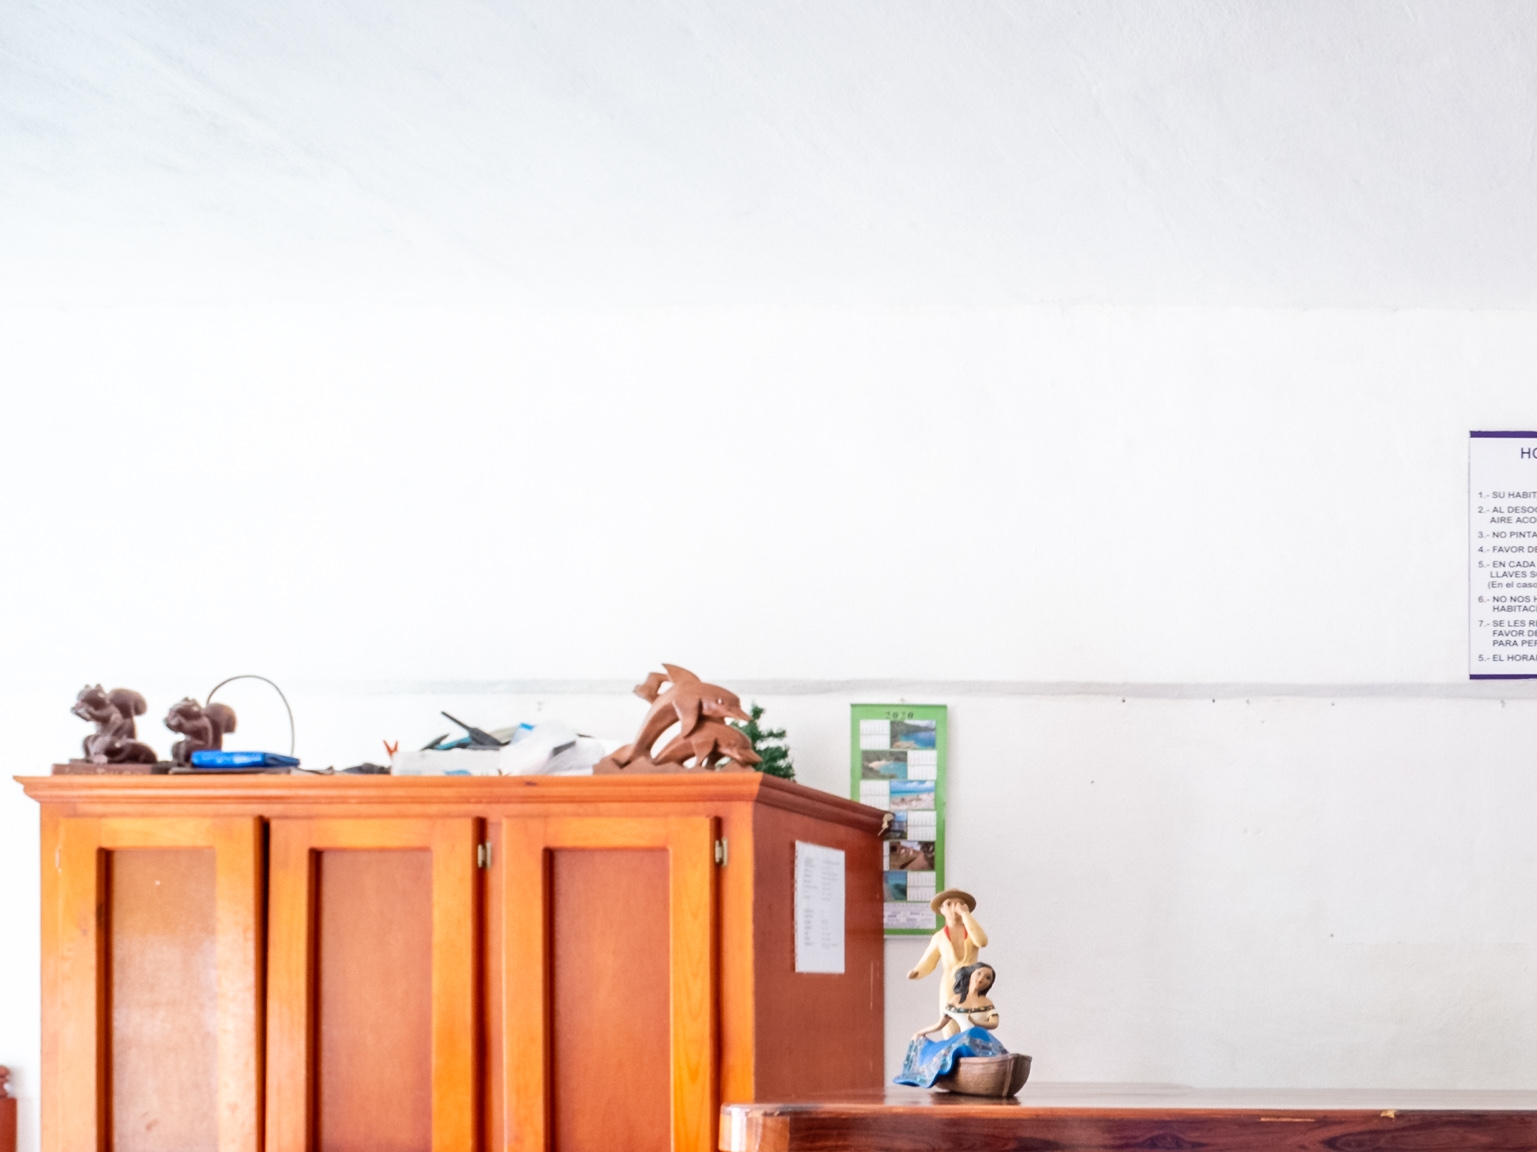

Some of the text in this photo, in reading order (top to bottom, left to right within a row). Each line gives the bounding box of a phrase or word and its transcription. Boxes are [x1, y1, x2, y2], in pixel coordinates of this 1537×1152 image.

[1491, 491, 1506, 499] SU
[1491, 505, 1505, 514] AL
[1489, 516, 1513, 524] AIRE
[1492, 530, 1508, 539] NO
[1492, 545, 1525, 554] FAVOR
[1492, 560, 1506, 568] EN
[1508, 560, 1536, 568] CADA
[1489, 570, 1528, 578] LLAVES
[1492, 594, 1508, 603] NO
[1509, 594, 1531, 603] NOS
[1492, 619, 1505, 627] SE
[1507, 619, 1527, 627] LES
[1492, 629, 1525, 638] FAVOR
[1492, 639, 1519, 647] PARA
[1492, 653, 1504, 662] EL
